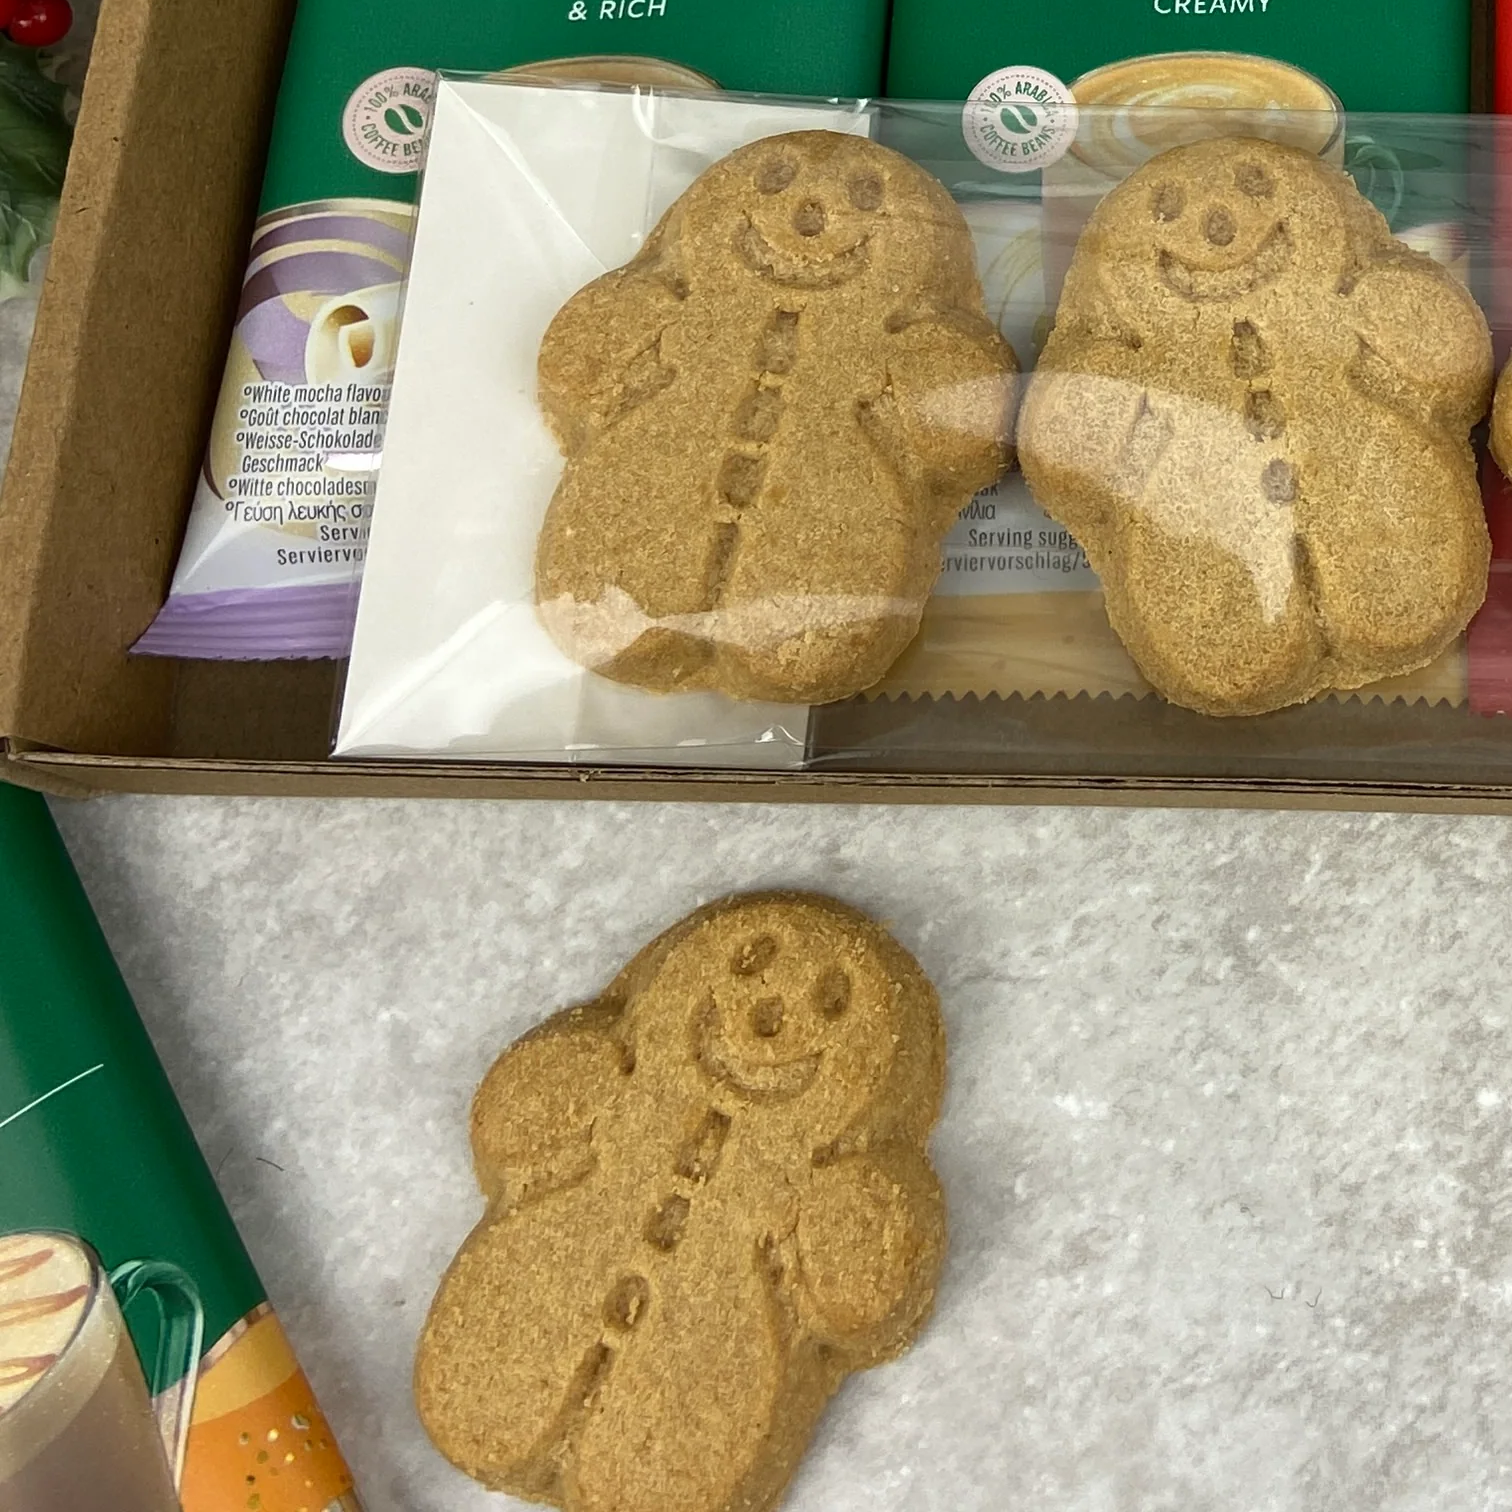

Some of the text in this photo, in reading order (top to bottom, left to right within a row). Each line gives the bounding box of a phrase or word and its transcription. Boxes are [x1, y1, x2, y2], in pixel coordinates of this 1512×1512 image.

[567, 0, 588, 21] &
[364, 84, 399, 113] 100%
[361, 123, 400, 157] COFFEE
[980, 124, 1056, 157] COFFEE BEANS
[294, 384, 343, 404] mocha
[283, 408, 345, 427] chocolat
[242, 453, 324, 473] Geschmack
[968, 528, 1033, 550] Serving
